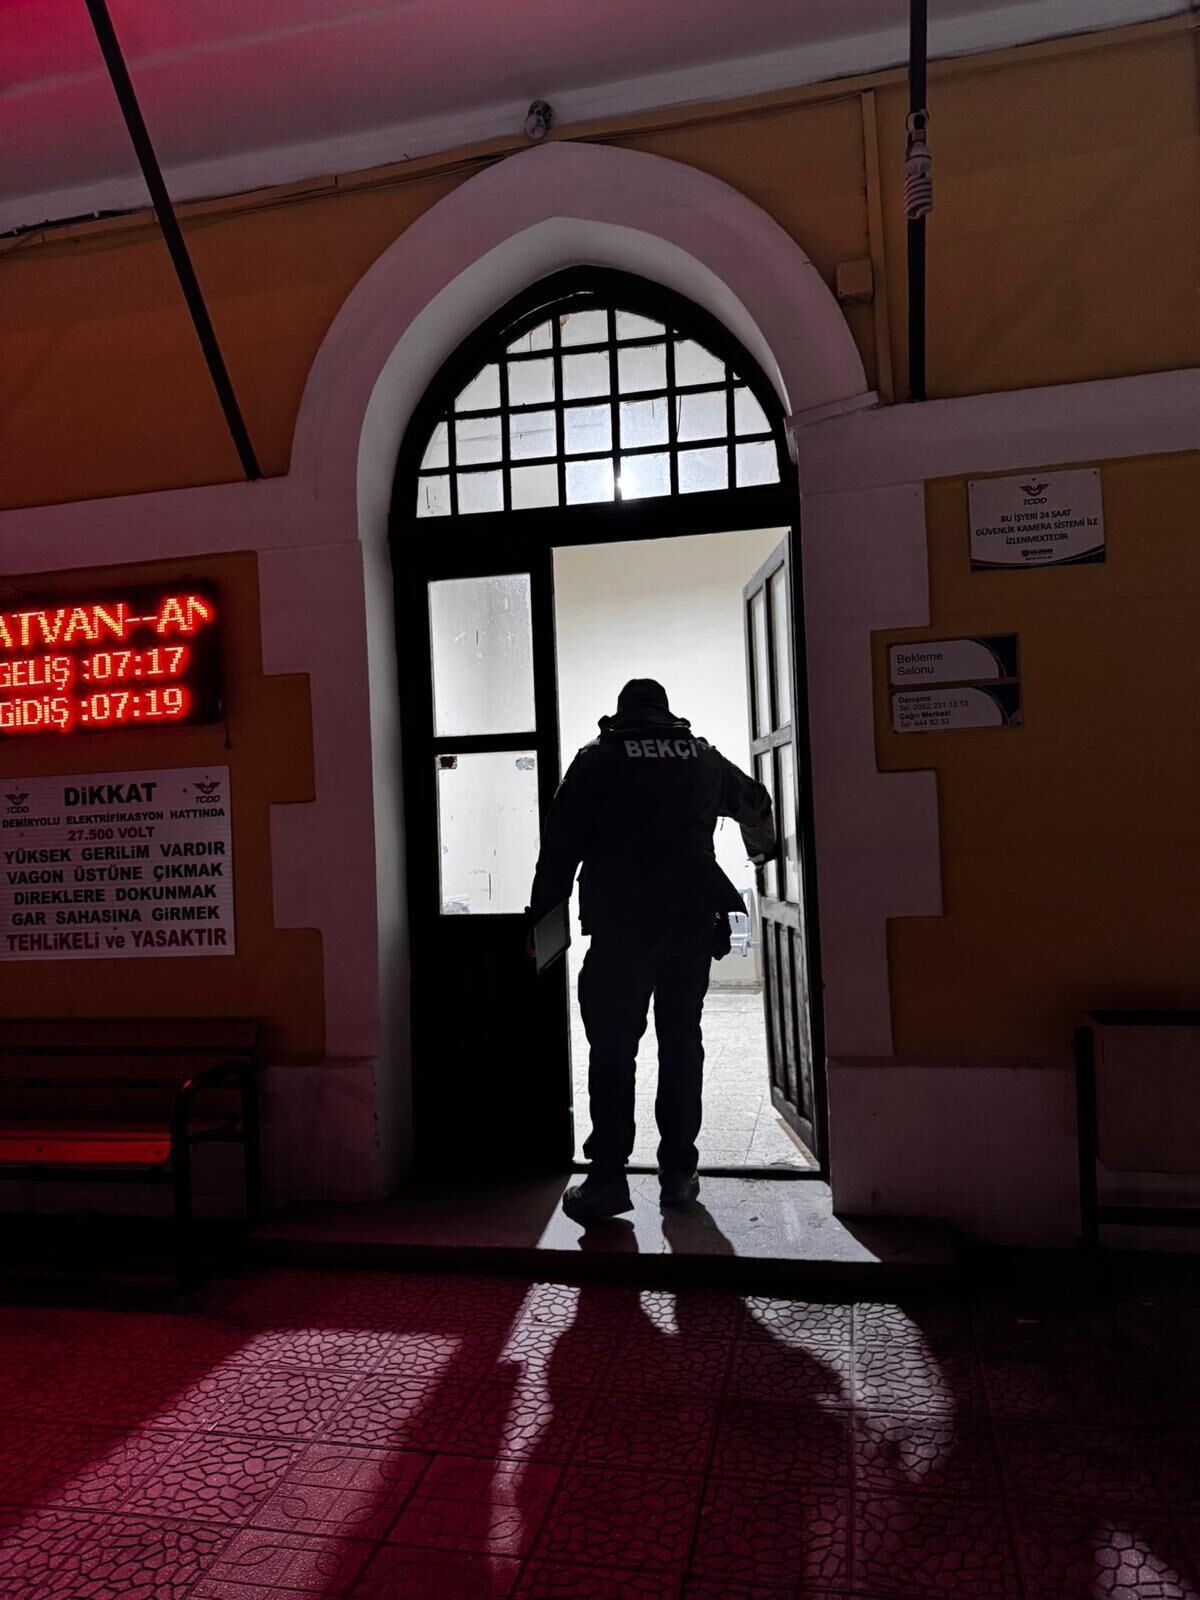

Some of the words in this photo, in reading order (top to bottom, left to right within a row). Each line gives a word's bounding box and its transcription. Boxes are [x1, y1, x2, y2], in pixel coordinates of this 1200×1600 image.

[1001, 514, 1012, 523] BU
[1040, 511, 1050, 520] 24
[1051, 509, 1072, 518] SAAT
[976, 525, 1016, 537] GÜVENLİK
[1017, 523, 1052, 533] KAMERA
[1054, 519, 1086, 530] SİSTEMİ
[1087, 517, 1099, 526] İLE
[1006, 531, 1069, 545] İZLENMEKTEDİR
[897, 651, 943, 664] Bekleme
[897, 666, 935, 676] Salonu
[195, 795, 221, 804] TCDD
[2, 816, 60, 828] DEMİRYOLU
[66, 810, 164, 825] ELEKTRİFİKASYON
[170, 808, 225, 819] HATTINDA
[68, 827, 114, 841] 27.500
[118, 826, 155, 839] VOLT
[5, 847, 72, 864] YÜKSEK
[160, 841, 225, 857] VARDIR
[7, 870, 64, 885] VAGON
[74, 865, 143, 882] ÜSTÜNE
[153, 863, 223, 883] ÇIKMAK
[115, 884, 217, 902] DOKUNMAK
[12, 912, 46, 926] GAR
[56, 909, 142, 924] SAHASINA
[105, 935, 126, 949] ve
[131, 928, 227, 948] YASAKTIR
